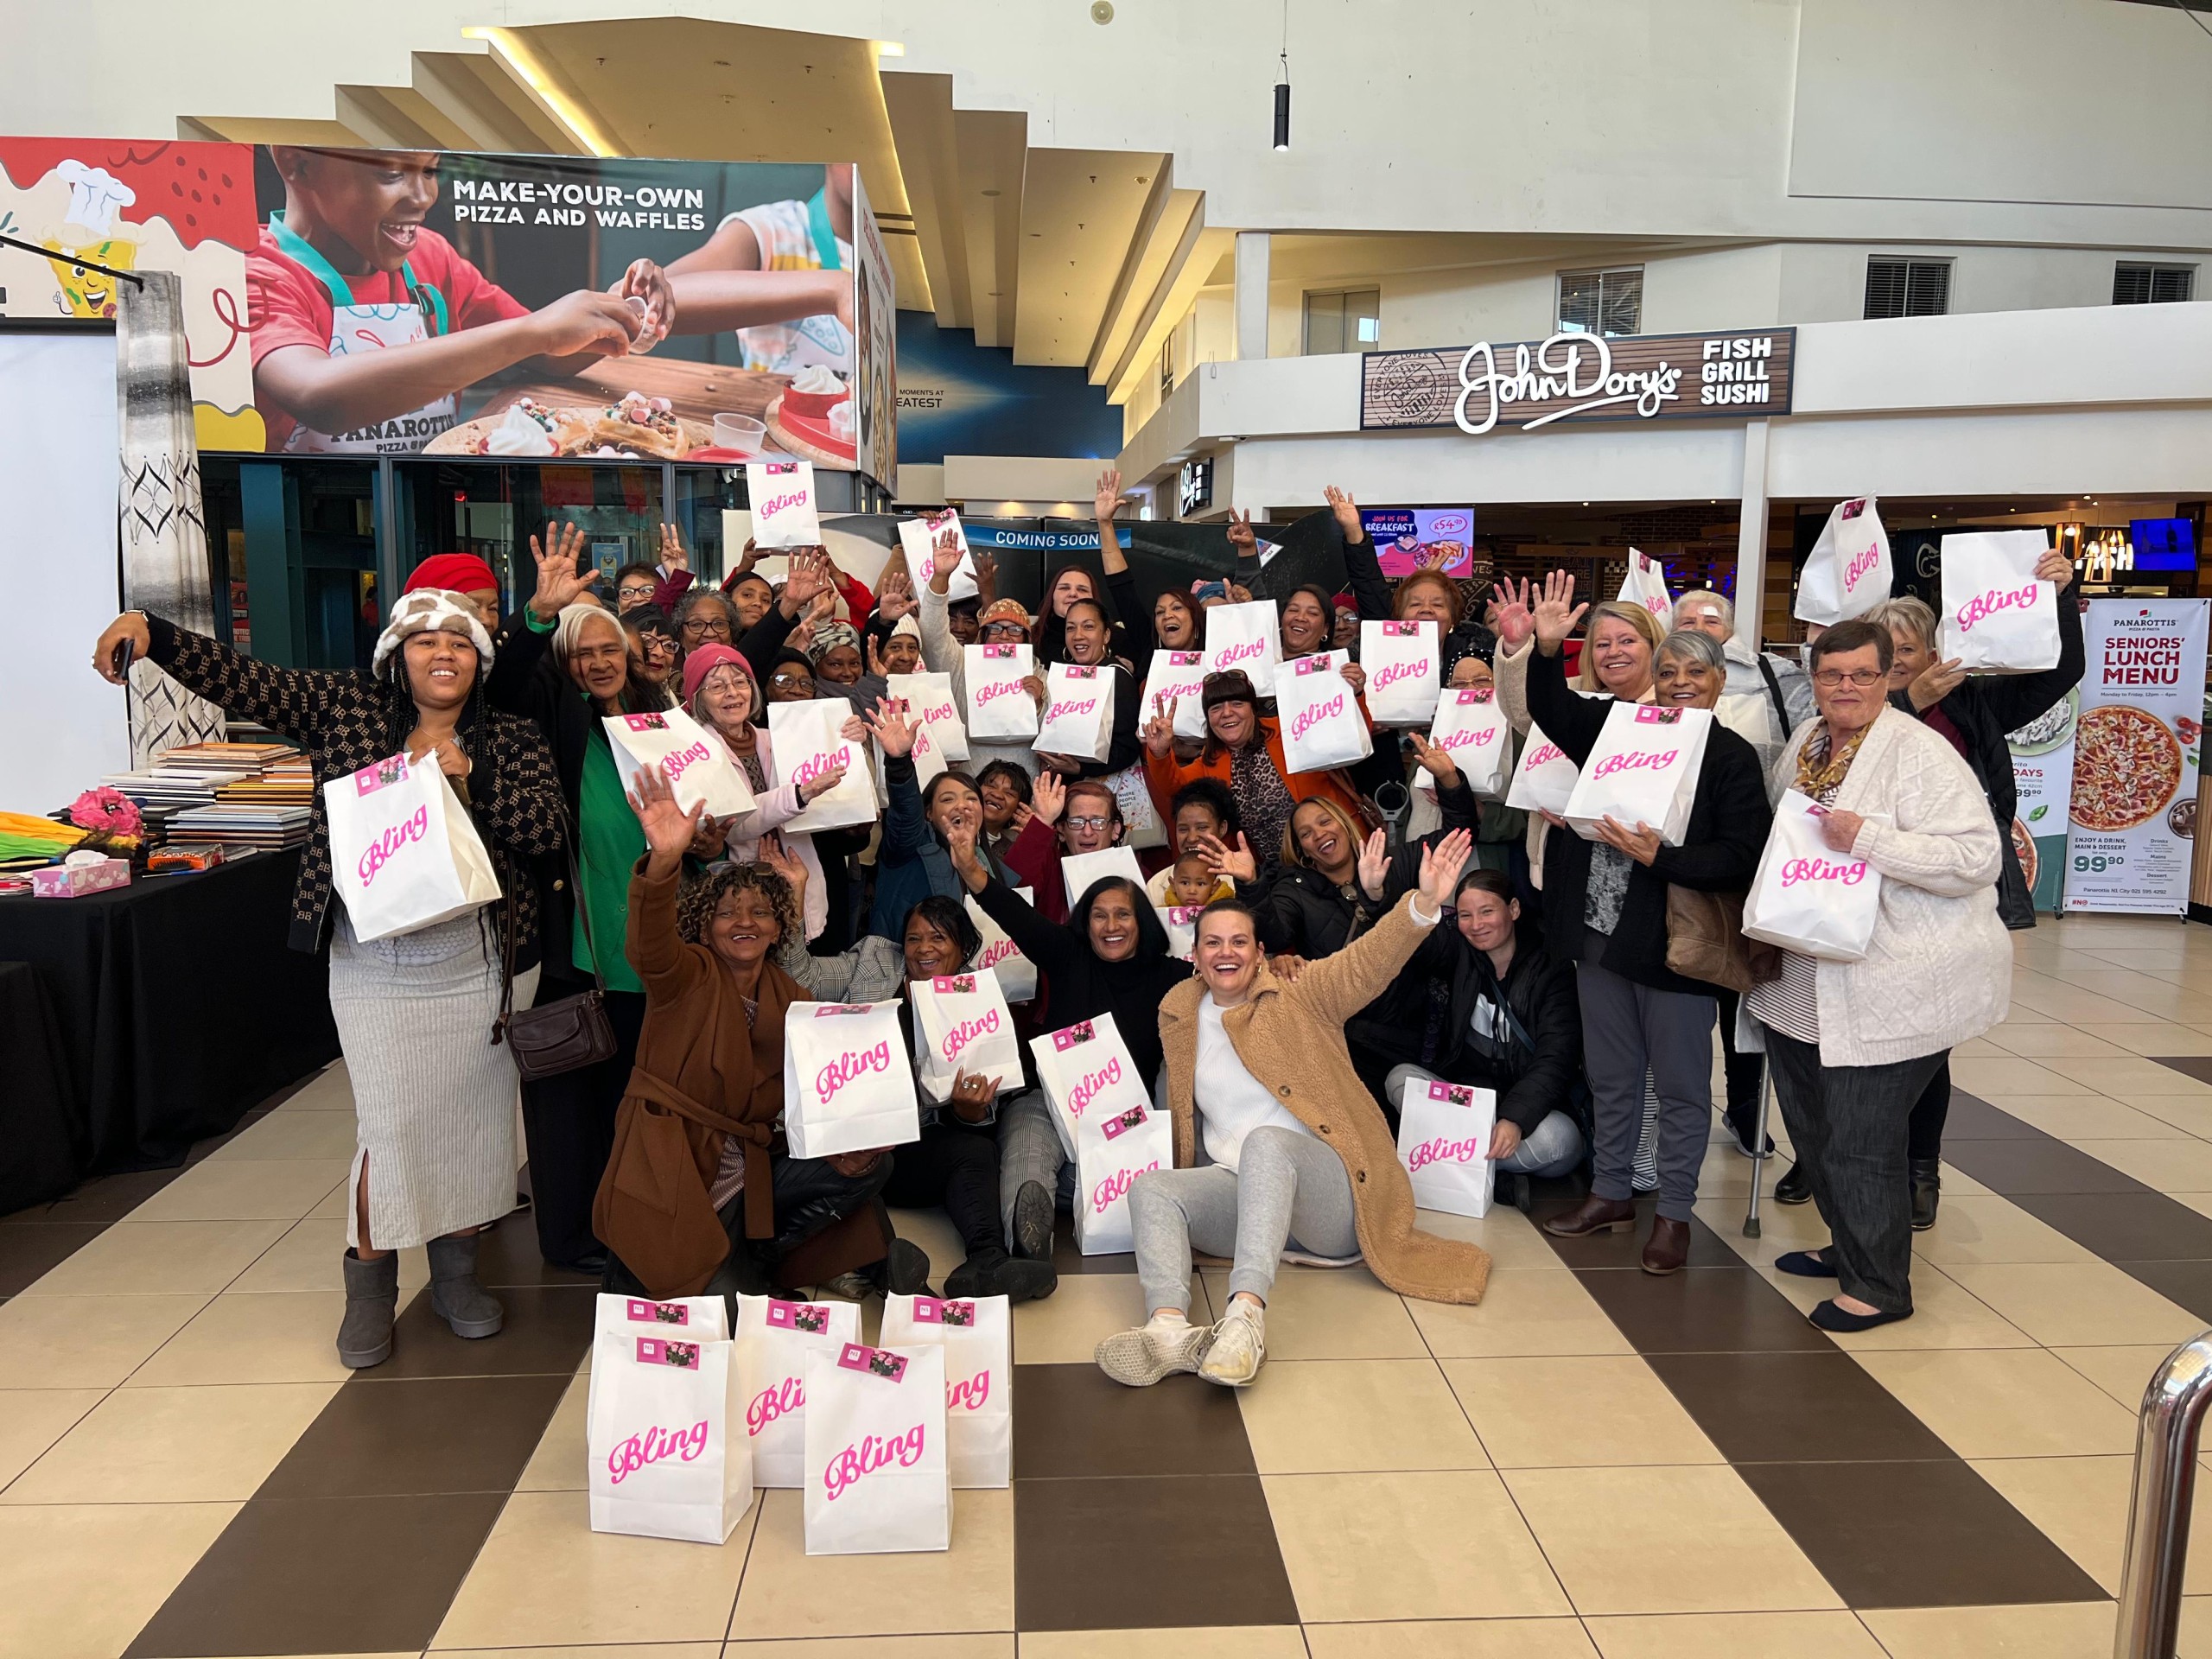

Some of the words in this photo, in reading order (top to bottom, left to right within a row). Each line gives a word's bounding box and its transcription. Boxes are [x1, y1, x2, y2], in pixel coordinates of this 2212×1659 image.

[453, 180, 703, 209] MAKE-YOUR-OWN
[454, 205, 524, 225] PIZZA
[534, 208, 586, 226] AND
[594, 210, 705, 231] WAFFLES
[1702, 337, 1772, 360] FISH
[1701, 359, 1770, 383] GRILL
[896, 397, 942, 408] EATEST
[1700, 383, 1770, 405] SUSHI
[376, 442, 408, 453] PIZZA
[760, 490, 807, 520] Bling
[995, 531, 1056, 548] COMING
[1059, 533, 1099, 547] SOON
[1365, 523, 1414, 532] BREAKFAST
[1473, 565, 1493, 575] VES
[1844, 542, 1879, 594] Bling
[1956, 582, 2038, 632] Bling
[1214, 637, 1265, 673] Bling
[2104, 651, 2180, 665] LUNCH
[2105, 637, 2185, 649] SENIORS'
[1373, 658, 1428, 693] Bling
[2102, 668, 2178, 684] MENU
[976, 678, 1024, 708] Bling
[1151, 681, 1204, 710] Bling
[923, 702, 953, 725] ling
[1046, 698, 1096, 725] Bling
[1291, 693, 1344, 742] Bling
[661, 741, 711, 782] Bling
[791, 745, 851, 788] Bling
[1524, 743, 1569, 772] Bli
[1592, 749, 1679, 781] Bling
[2013, 768, 2043, 777] DAYS
[358, 804, 428, 887] Bling
[1781, 857, 1867, 888] Bling
[942, 1008, 1000, 1063] Bling
[815, 1040, 891, 1105] Bling
[1067, 1056, 1122, 1120] Bling
[1408, 1136, 1478, 1173] Bling
[947, 1369, 990, 1411] ing
[746, 1376, 806, 1437] Bli
[607, 1420, 709, 1485] Bling
[823, 1423, 925, 1502] Bling
